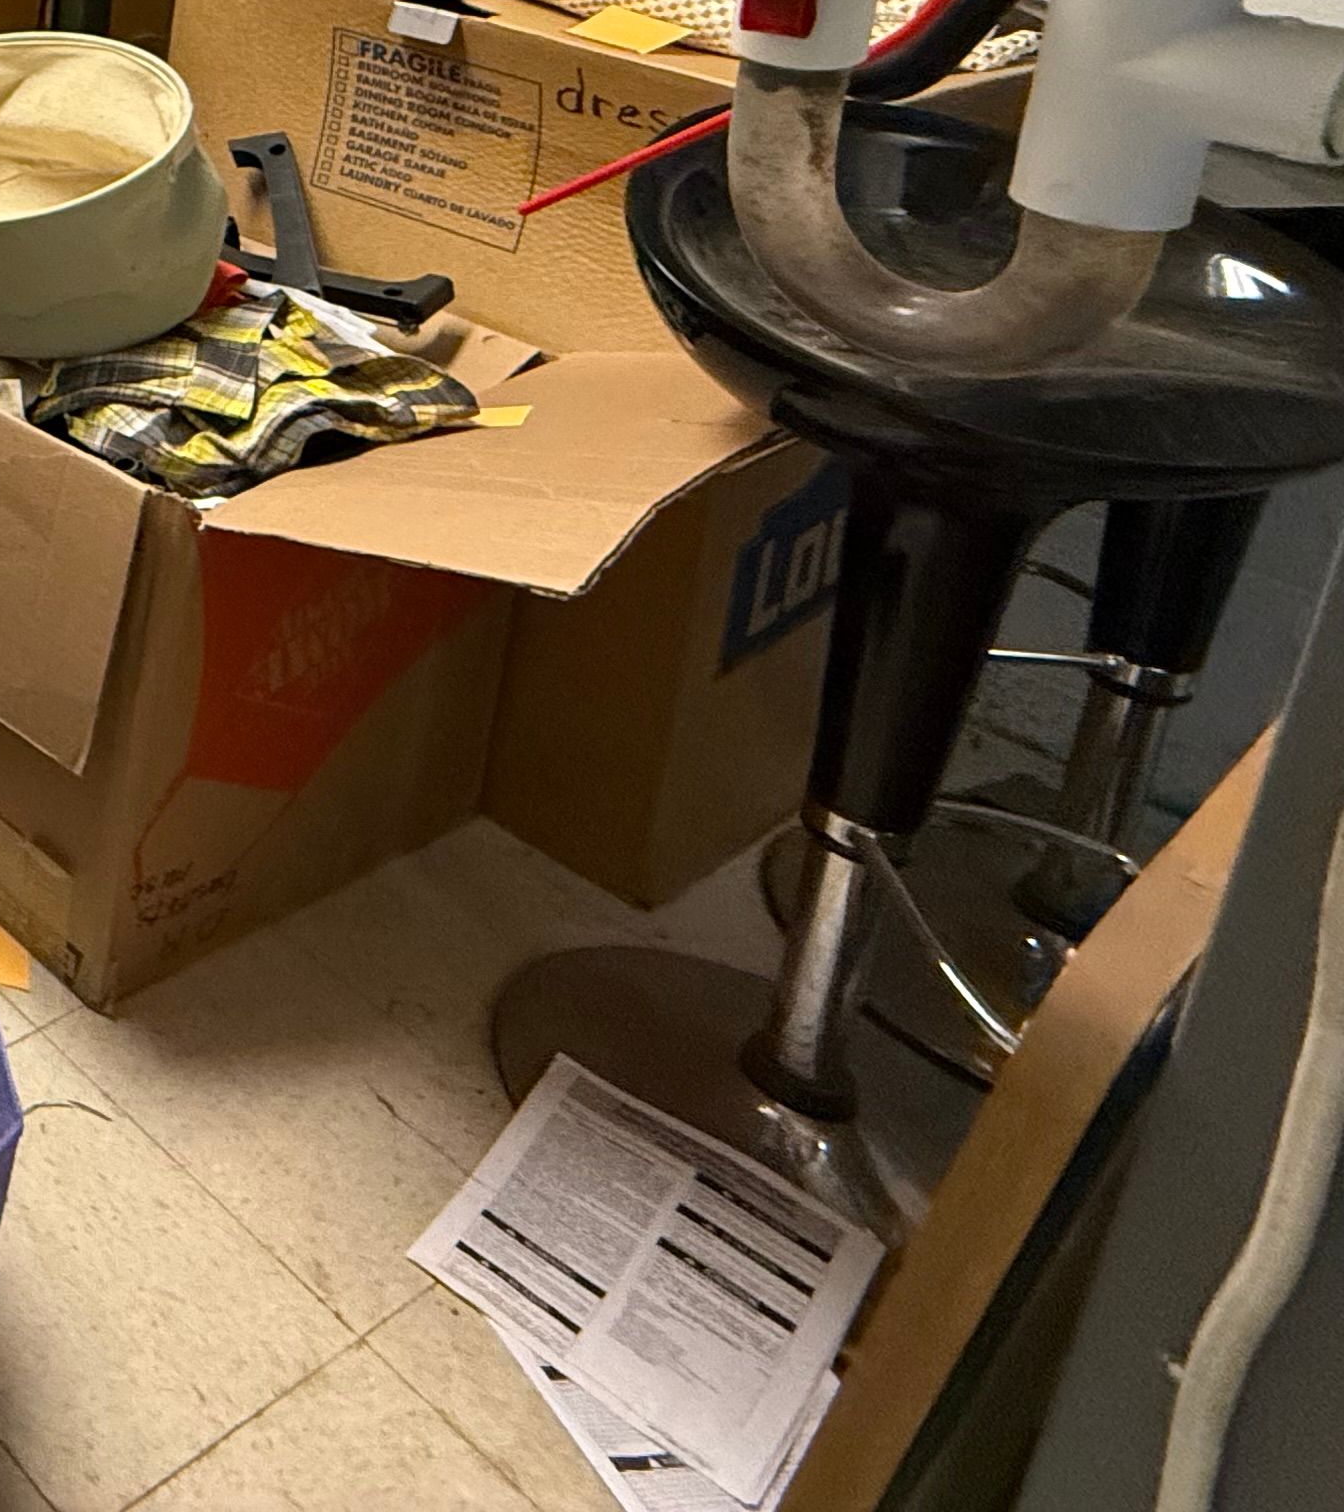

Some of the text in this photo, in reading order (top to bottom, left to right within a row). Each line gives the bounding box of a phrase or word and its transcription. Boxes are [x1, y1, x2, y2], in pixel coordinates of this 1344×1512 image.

[356, 39, 466, 84] FRAGILE
[357, 60, 424, 87] BEDROOM
[355, 74, 401, 95] FAMILY
[352, 101, 409, 124] KITCHEN
[353, 87, 405, 109] DINING
[407, 102, 452, 122] ROOM
[556, 68, 684, 134] dres
[350, 114, 386, 131] BATH
[345, 140, 401, 164] GARAGE
[347, 127, 417, 155] BASEMENT
[342, 154, 378, 172] ATTIC
[338, 166, 401, 194] LAUNDRY
